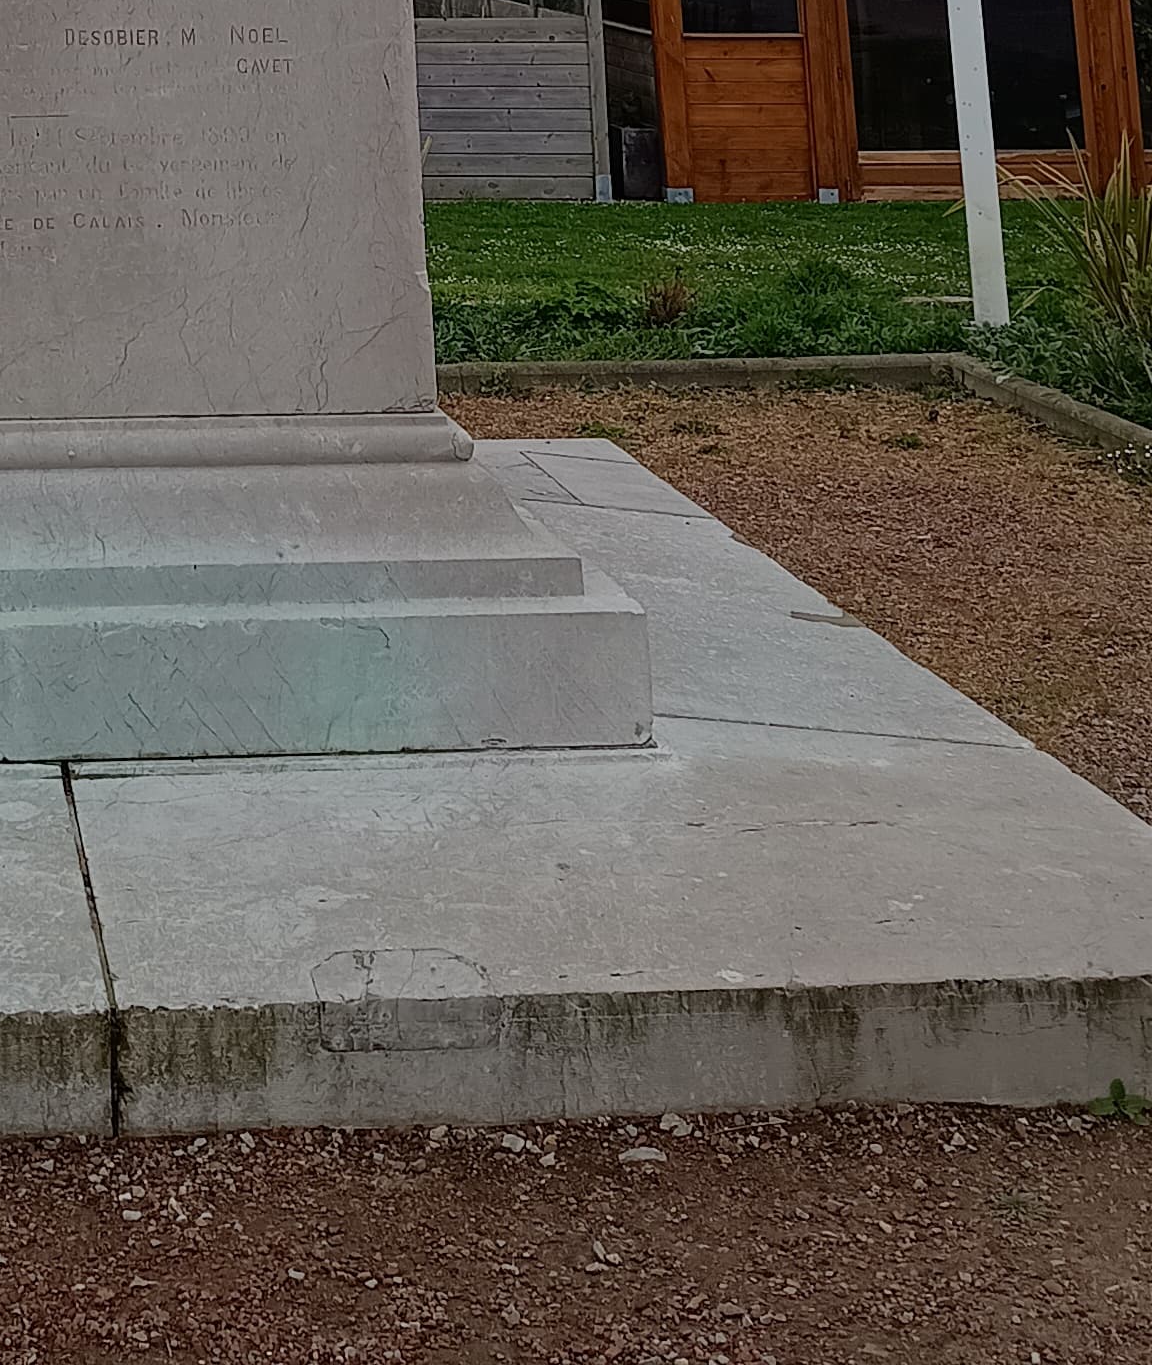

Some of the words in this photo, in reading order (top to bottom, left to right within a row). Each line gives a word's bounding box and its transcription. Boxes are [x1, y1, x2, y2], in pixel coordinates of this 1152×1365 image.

[64, 28, 160, 47] DESOBIER
[229, 25, 289, 45] NOEL
[236, 58, 294, 75] GAVET
[33, 217, 55, 231] DE
